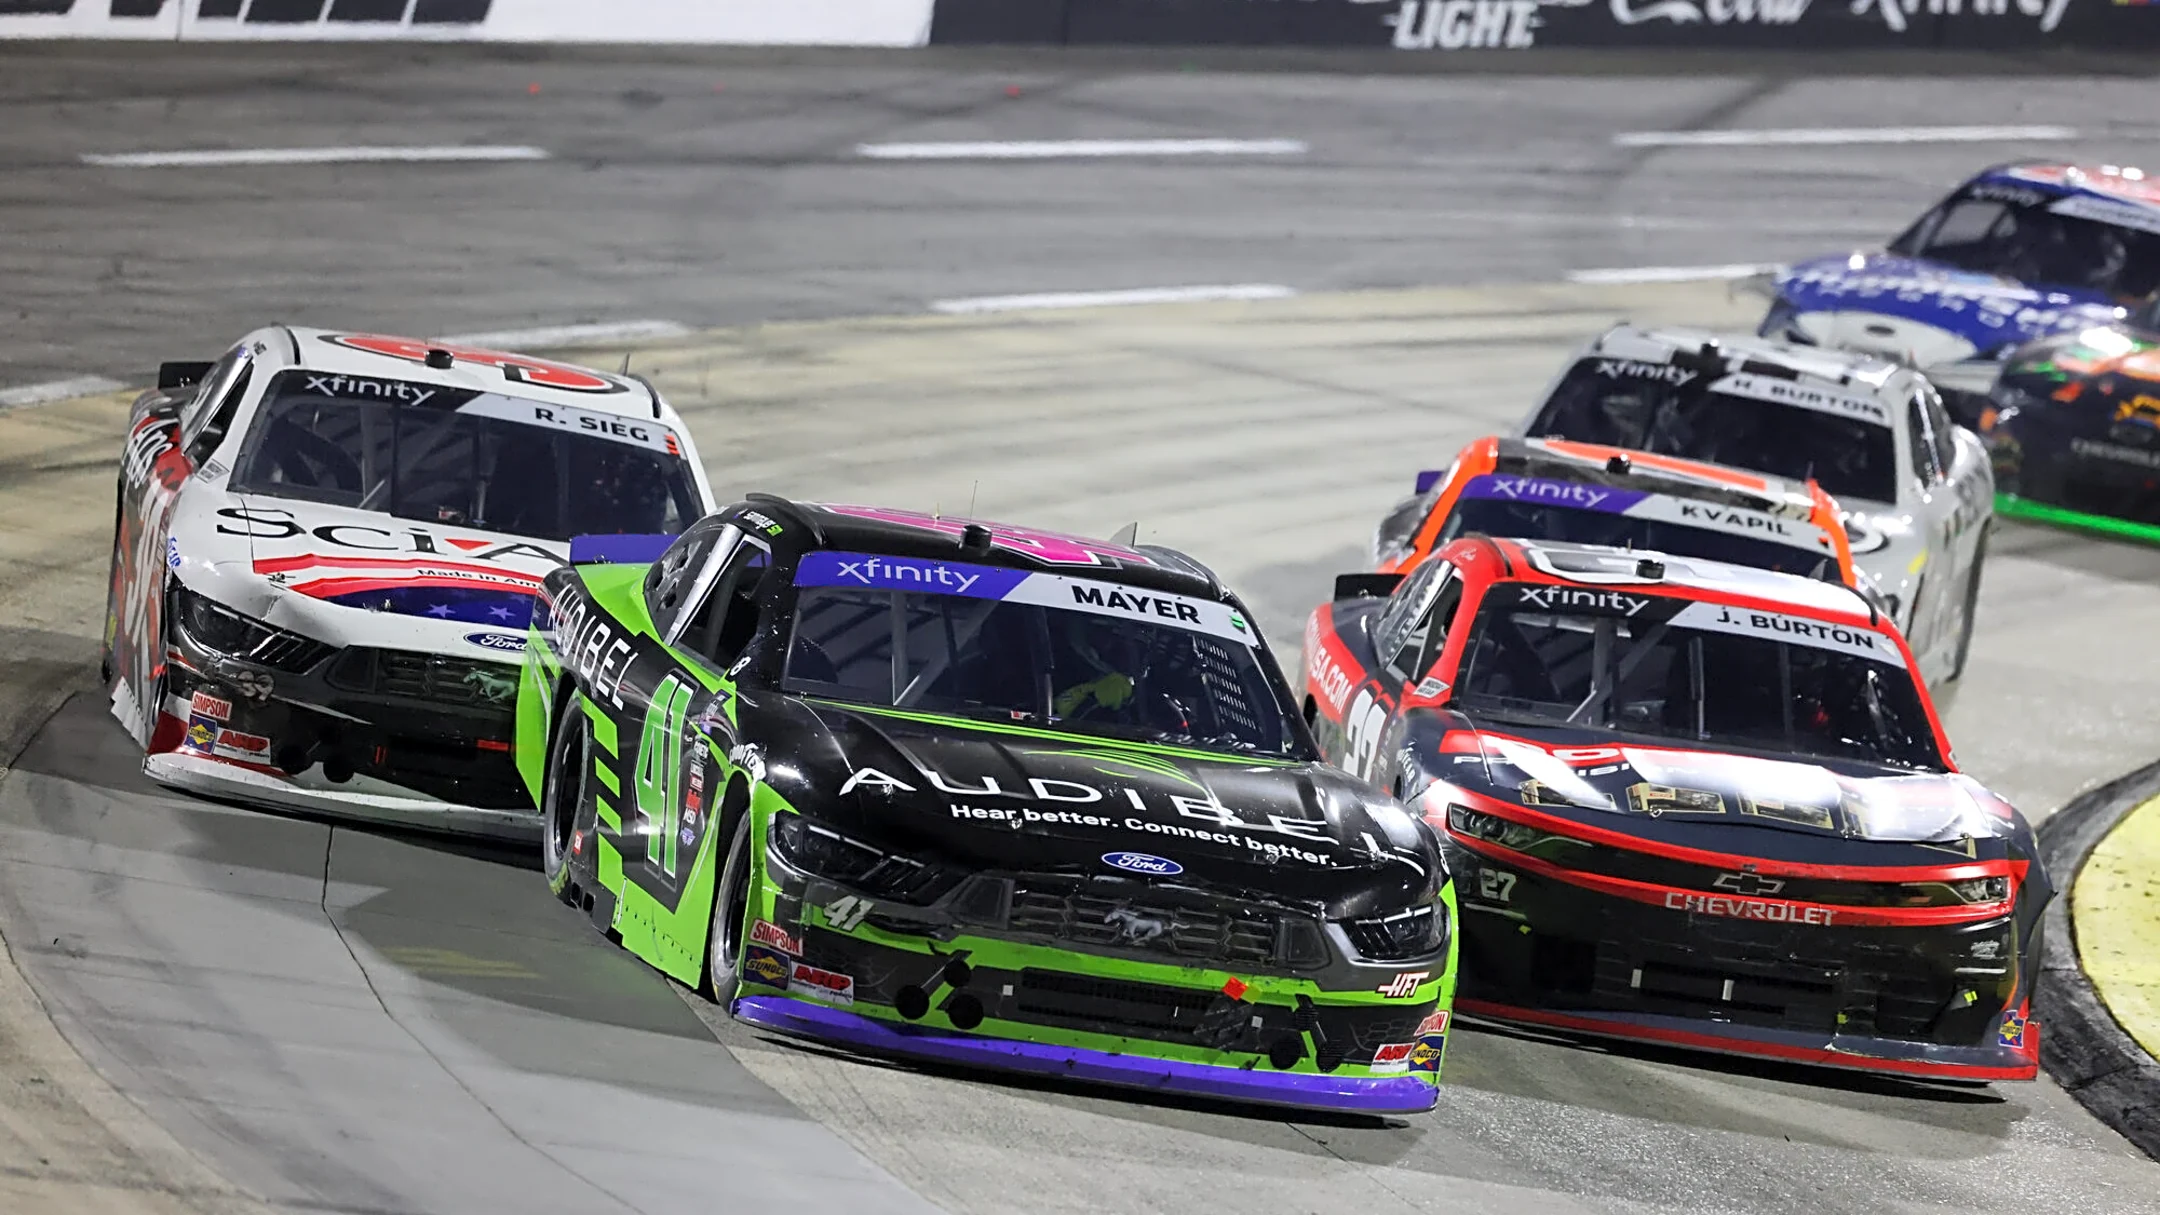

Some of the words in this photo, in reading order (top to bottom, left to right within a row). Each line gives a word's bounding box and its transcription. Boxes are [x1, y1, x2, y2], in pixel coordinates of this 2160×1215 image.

[1596, 359, 1698, 387] xfinity
[305, 375, 436, 406] xfinity
[536, 407, 566, 425] R.
[580, 415, 649, 443] SIEG
[1492, 477, 1609, 507] xfinity
[1681, 504, 1792, 537] KVAPIL
[418, 568, 471, 579] Made
[477, 573, 498, 582] in
[837, 556, 981, 593] xfinity
[1071, 584, 1202, 624] MAYER
[1520, 585, 1650, 616] xfinity
[1716, 607, 1741, 626] J.
[1751, 613, 1875, 650] BURTON
[192, 693, 230, 718] SIMPSON
[634, 673, 694, 879] 41
[839, 767, 1425, 877] AUDIBEL
[950, 804, 1017, 821] Hear
[1022, 807, 1119, 828] better.
[1125, 818, 1241, 847] Connect
[1245, 837, 1339, 867] better.
[1116, 853, 1168, 873] Ford
[1479, 867, 1517, 902] 27
[823, 895, 874, 933] 41
[1665, 891, 1838, 927] CHEVROLET
[753, 920, 801, 954] SIMPSON
[793, 964, 852, 991] ARP
